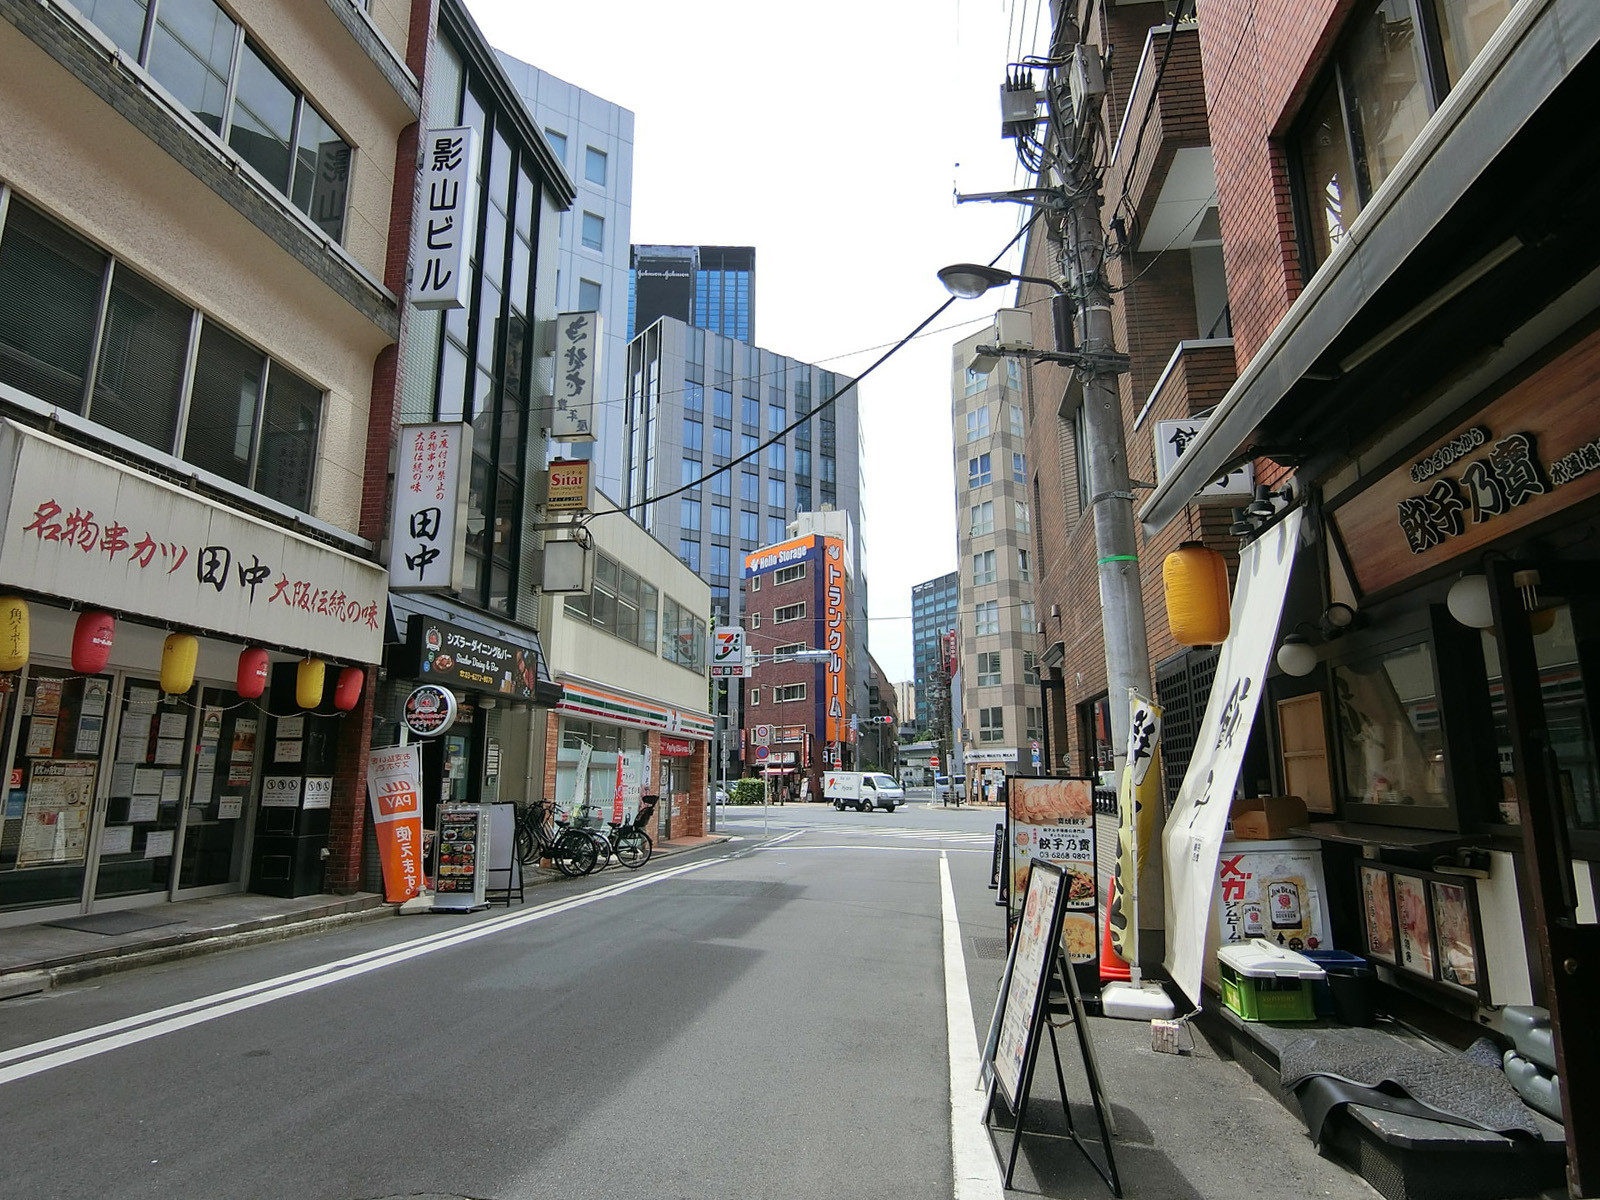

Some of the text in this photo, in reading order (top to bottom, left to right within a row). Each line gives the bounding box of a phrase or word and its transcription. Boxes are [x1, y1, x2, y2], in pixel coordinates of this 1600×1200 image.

[420, 137, 463, 292] 影山ビル
[410, 432, 426, 493] 大阪伝統の味
[426, 431, 438, 482] 名物串カツ
[435, 429, 449, 501] 二度付け禁止の
[551, 473, 584, 486] Sitar
[1549, 437, 1600, 485] 水道橋
[22, 498, 380, 632] 名物串カツ 田中 大阪伝統の味
[405, 507, 441, 582] 田中
[759, 545, 807, 570] Hello Storage
[9, 607, 22, 656] 角ハイボール
[828, 564, 842, 718] トランクルーム
[1051, 851, 1070, 860] 6268
[1072, 852, 1090, 860] 9897
[1220, 854, 1253, 902] メガ
[1270, 886, 1297, 898] JIM BEAM
[1224, 900, 1242, 943] ジムビーム
